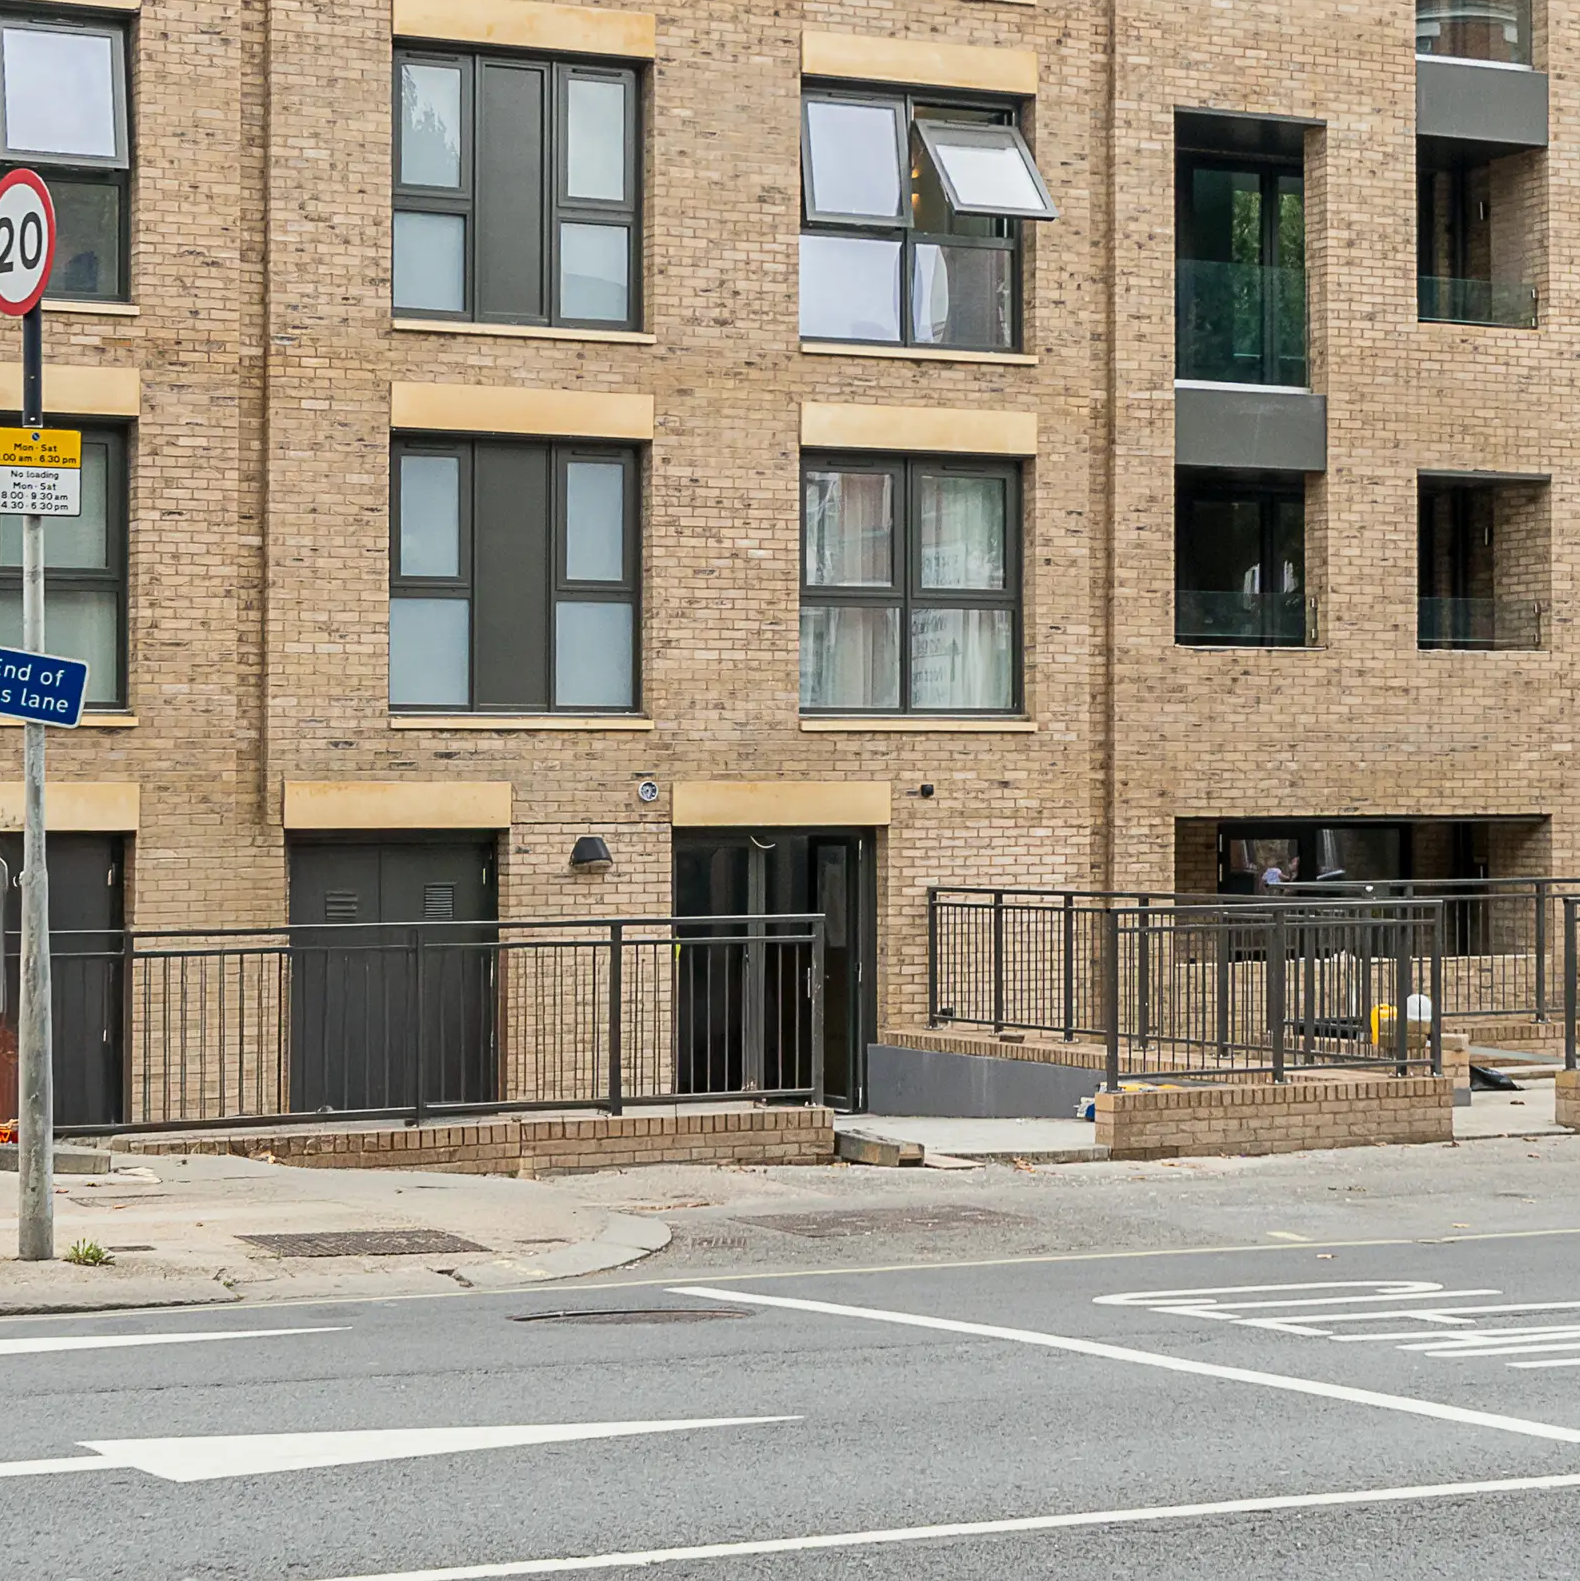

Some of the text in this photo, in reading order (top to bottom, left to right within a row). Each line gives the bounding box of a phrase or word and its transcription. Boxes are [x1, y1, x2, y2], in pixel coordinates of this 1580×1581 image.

[13, 443, 34, 451] Mon
[41, 444, 57, 452] Sat
[10, 470, 59, 480] No loading
[40, 669, 65, 687] of
[20, 687, 69, 713] lane
